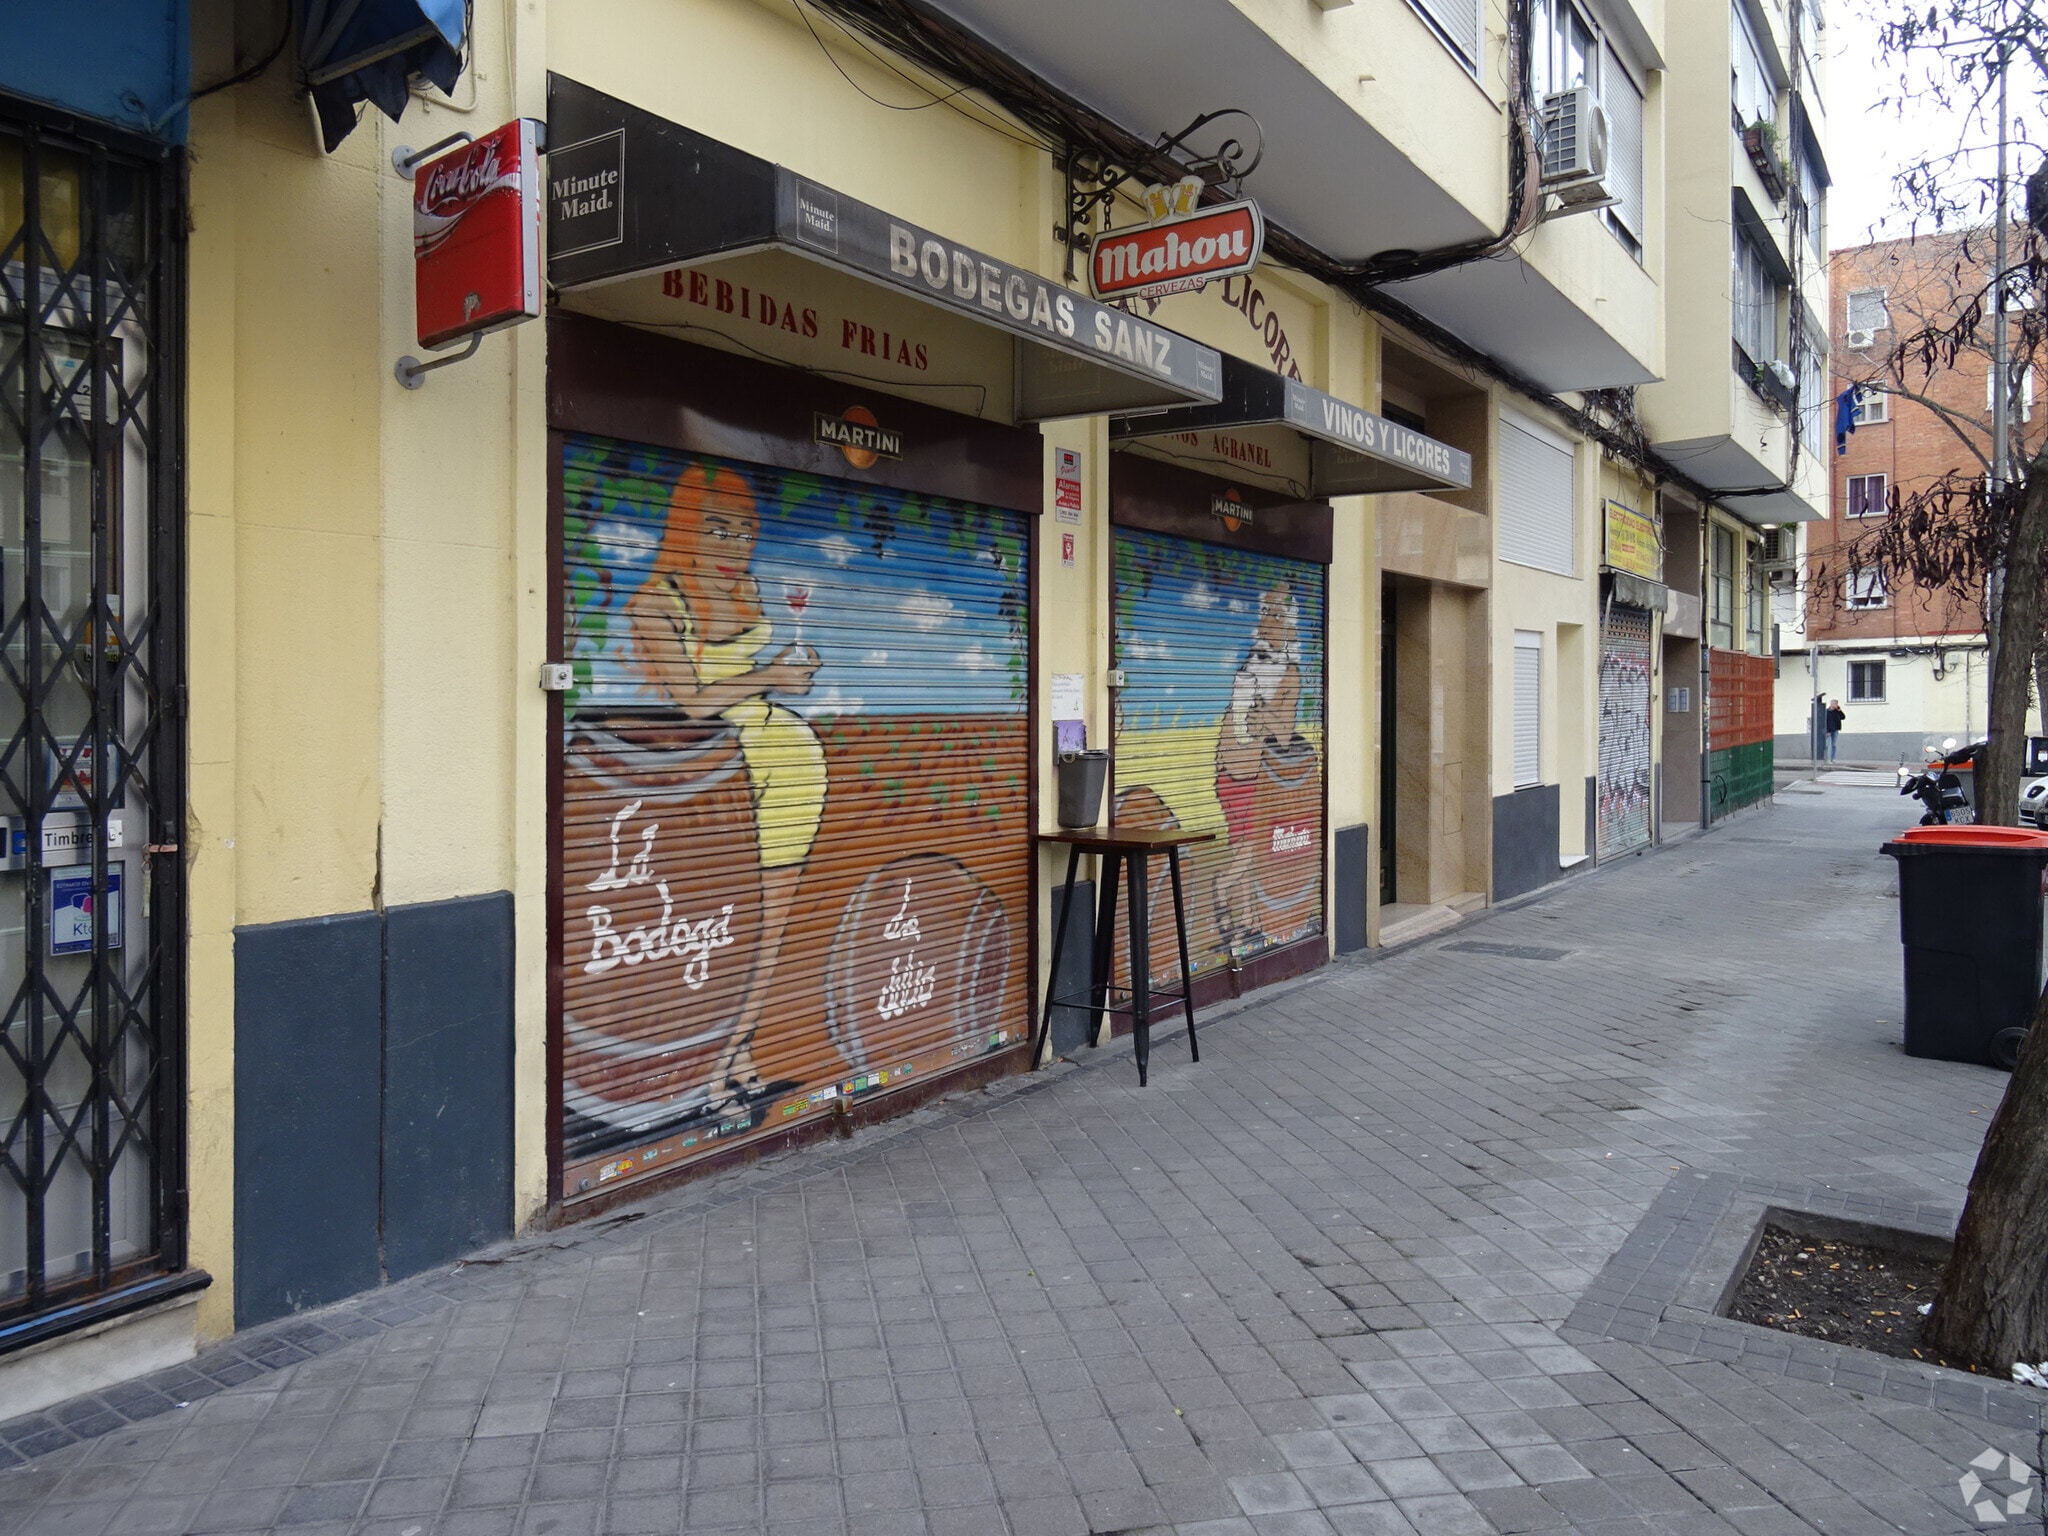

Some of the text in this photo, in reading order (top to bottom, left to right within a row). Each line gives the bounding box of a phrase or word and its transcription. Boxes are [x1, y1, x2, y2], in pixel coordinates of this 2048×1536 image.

[552, 168, 619, 200] Minute
[800, 198, 835, 222] Minute
[890, 223, 1172, 375] BODEGAS SANZ
[1139, 276, 1204, 299] CERVEZAS
[662, 268, 928, 371] BEBIDAS FRIAS
[821, 418, 900, 454] MARTINI
[1212, 433, 1272, 468] AGRANEL
[1322, 398, 1451, 475] VINOS Y LICORES
[1215, 498, 1252, 521] MARTINI
[44, 831, 93, 847] Timbre
[584, 799, 660, 891] La
[584, 878, 735, 990] Bodega
